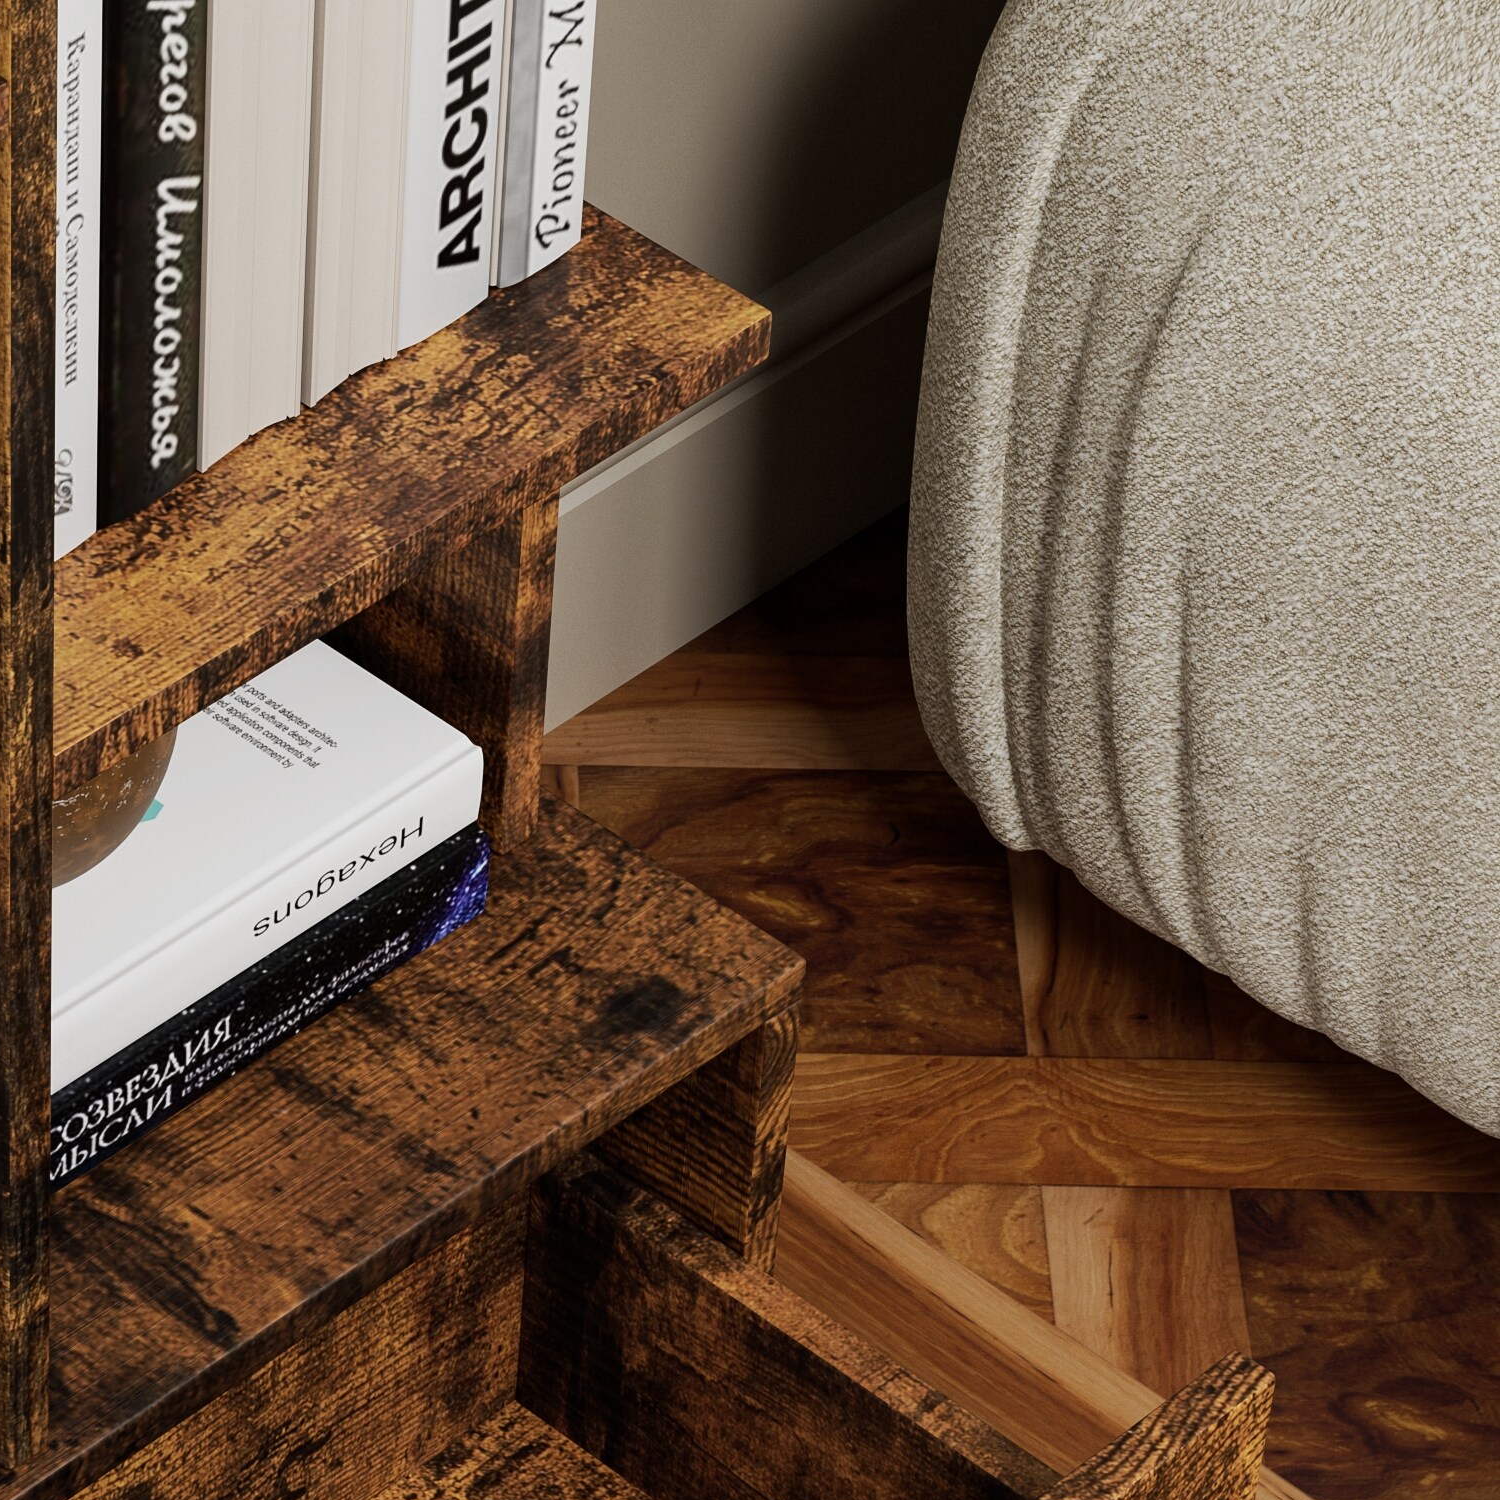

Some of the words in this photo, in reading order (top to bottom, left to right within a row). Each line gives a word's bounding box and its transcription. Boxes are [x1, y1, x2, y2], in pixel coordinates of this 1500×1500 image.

[63, 30, 86, 186] Карандаш
[66, 191, 79, 210] и
[535, 79, 579, 249] Pioneer
[62, 213, 84, 389] Самоделкин
[150, 175, 201, 470] Имоложья
[212, 713, 242, 734] software
[241, 731, 282, 762] environment
[282, 759, 294, 768] by
[226, 706, 263, 732] application
[262, 729, 304, 759] components
[302, 756, 320, 768] that
[234, 694, 256, 708] used
[252, 704, 261, 713] in
[259, 711, 289, 732] software
[246, 687, 267, 700] ports
[265, 699, 281, 710] and
[279, 707, 310, 729] adapters
[253, 816, 423, 937] Hexagons
